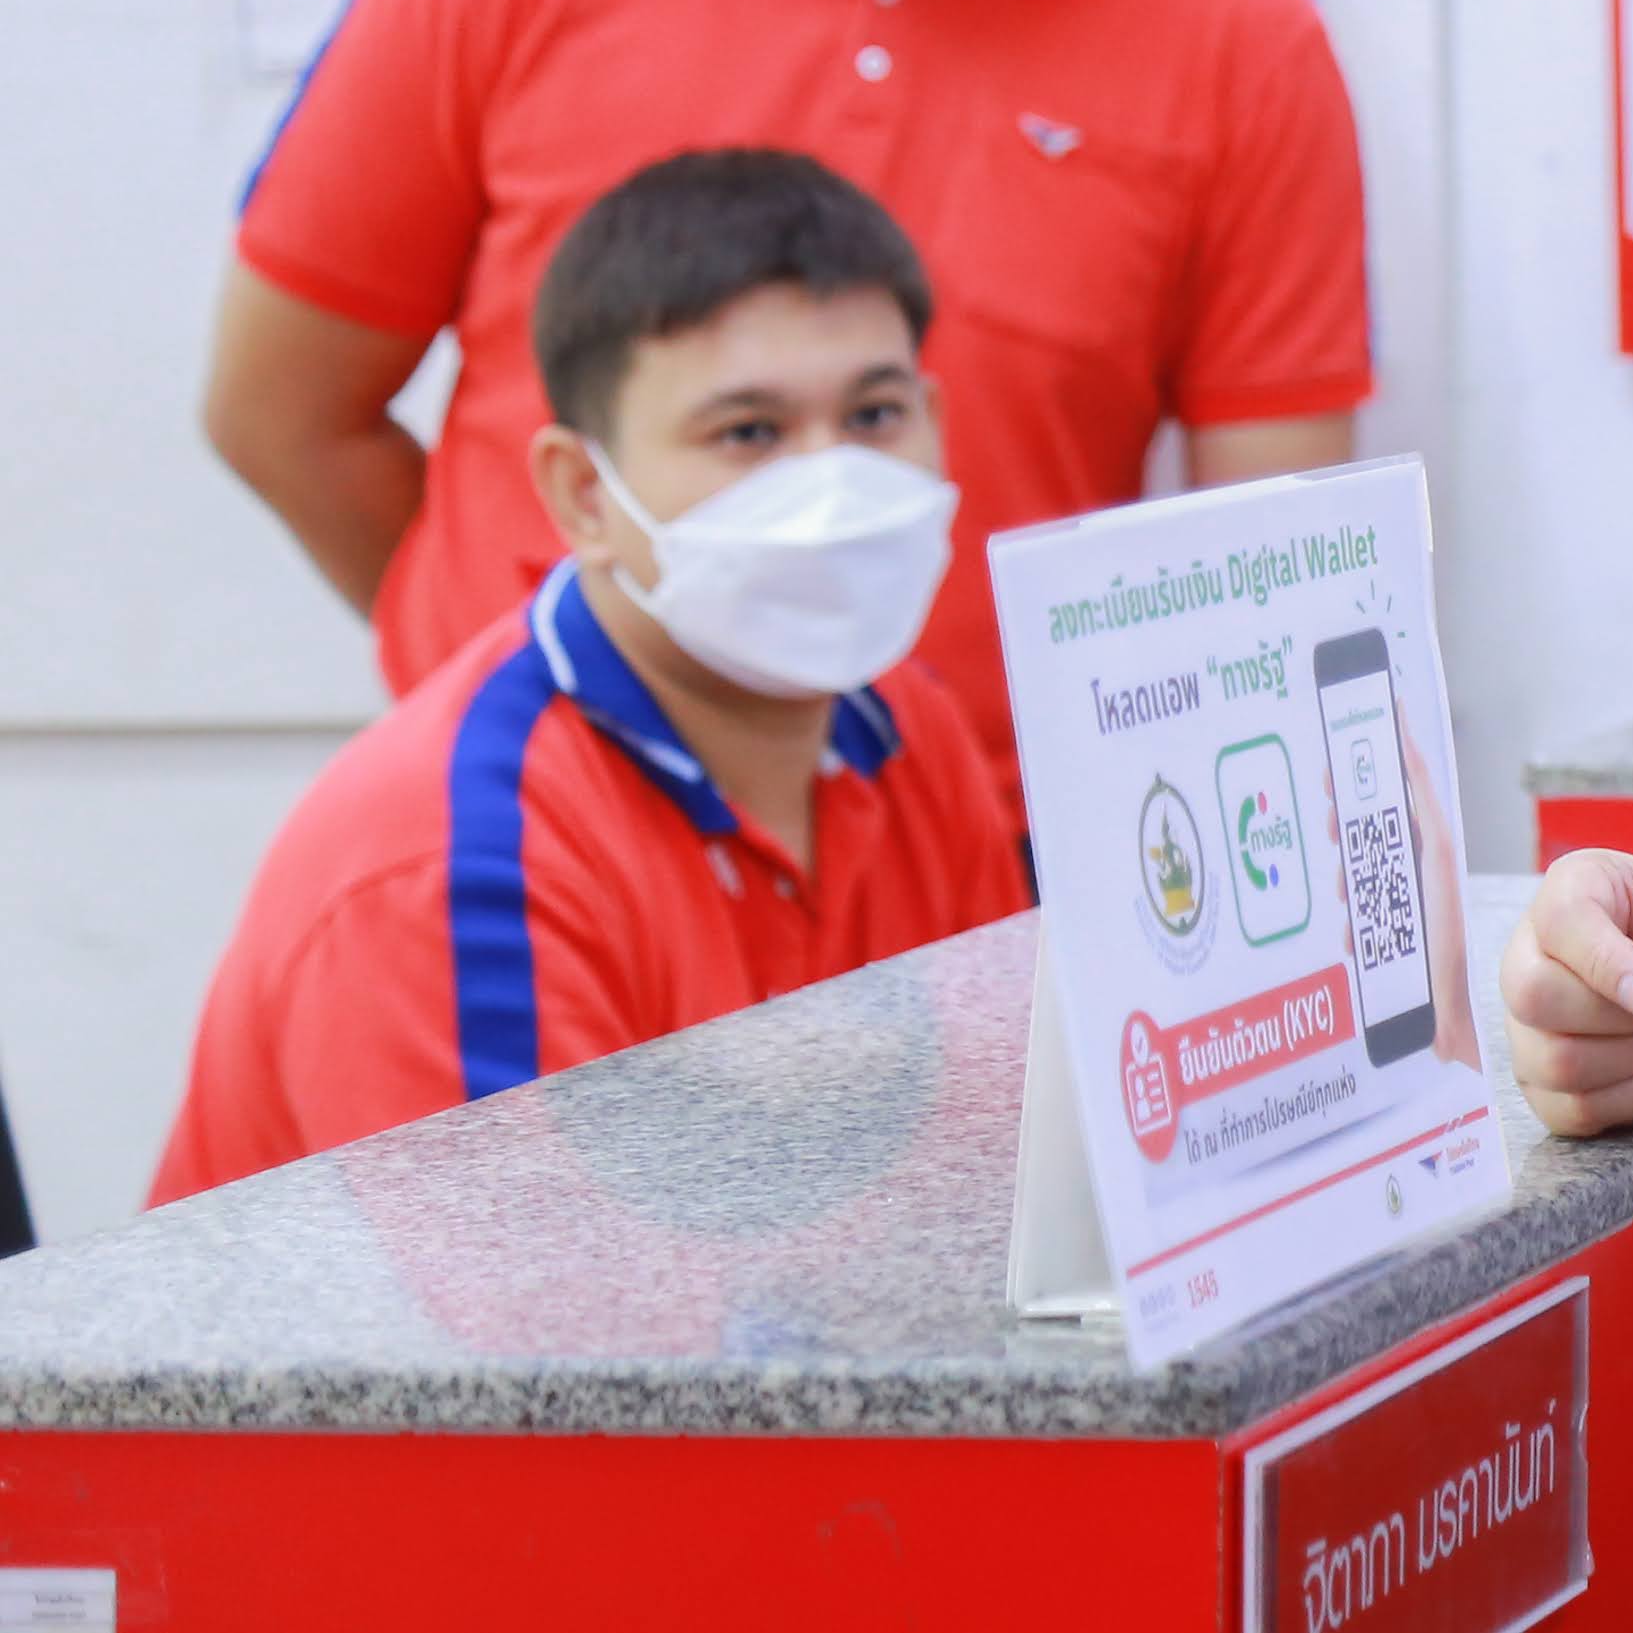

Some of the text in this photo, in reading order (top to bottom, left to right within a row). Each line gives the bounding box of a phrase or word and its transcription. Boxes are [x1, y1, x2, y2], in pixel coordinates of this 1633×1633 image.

[1048, 524, 1379, 644] ลงทะเบียนรับเงิน Digital Wallet
[1090, 671, 1201, 736] โหลดแอพ
[1250, 815, 1293, 853] ทางรัฐ
[1178, 984, 1335, 1086] ยืนยันตัวตน (KYC)
[1184, 1129, 1202, 1166] ได้
[1417, 1397, 1557, 1575] มรคานันท์
